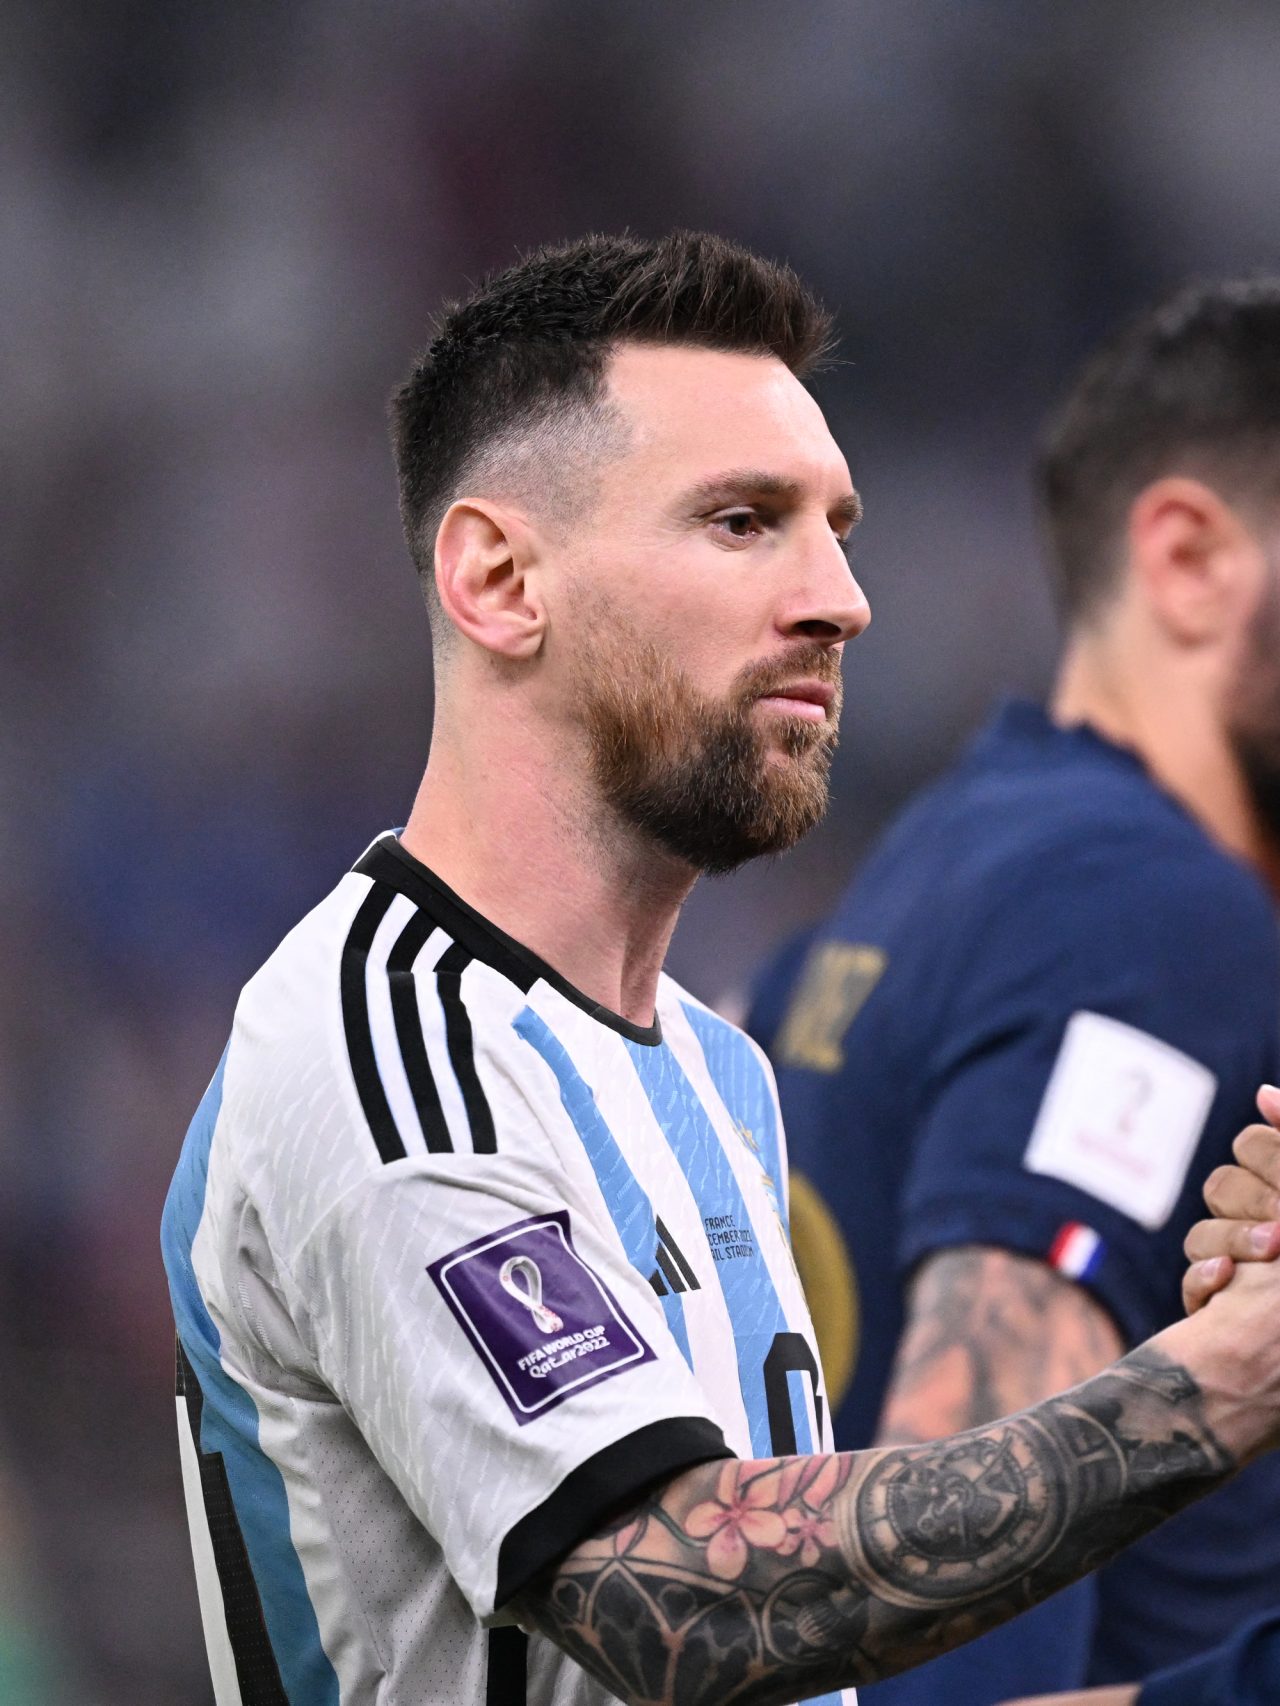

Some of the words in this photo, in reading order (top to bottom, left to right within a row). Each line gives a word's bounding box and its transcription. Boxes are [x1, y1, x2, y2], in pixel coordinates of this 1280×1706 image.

[704, 1215, 735, 1231] FRANCE
[706, 1230, 740, 1246] CEMBER
[710, 1248, 725, 1261] AIL
[517, 1349, 546, 1371] FIFA
[542, 1332, 585, 1355] WORLD
[583, 1325, 605, 1340] CUP
